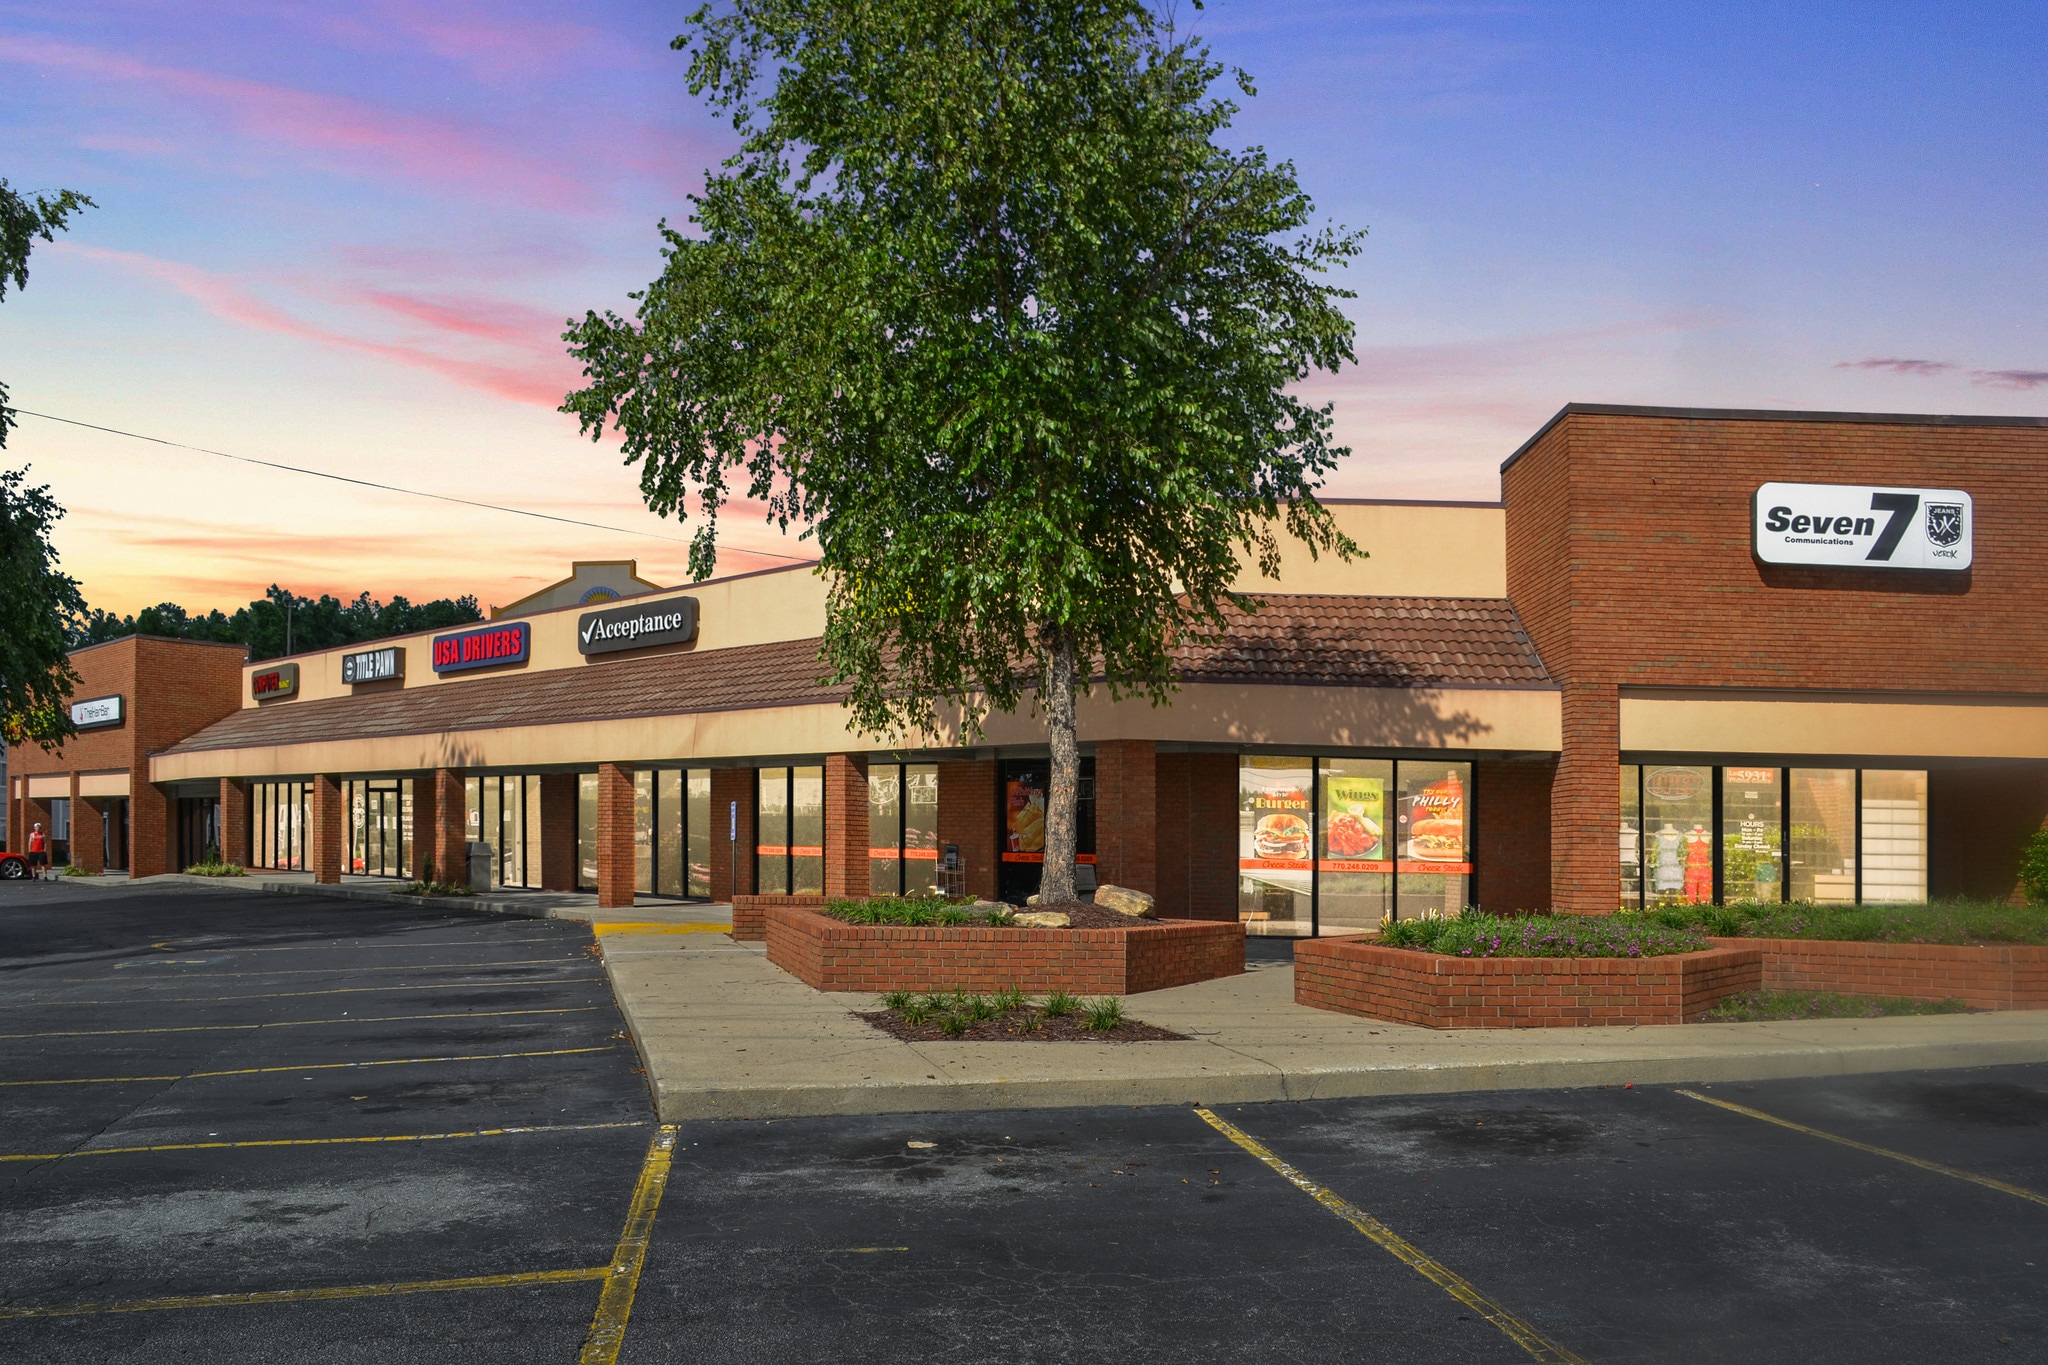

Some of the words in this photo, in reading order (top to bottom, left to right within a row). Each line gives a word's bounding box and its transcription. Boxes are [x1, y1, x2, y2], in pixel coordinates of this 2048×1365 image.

[1933, 507, 1955, 515] JEANS
[1765, 506, 1875, 536] Seven
[1865, 492, 1920, 562] 7
[1784, 536, 1854, 546] Communications
[594, 612, 682, 639] Acceptance
[434, 638, 460, 667] USA
[463, 628, 522, 662] DRIVERS
[355, 653, 374, 680] TITLE
[375, 649, 395, 678] PAWN
[1334, 788, 1379, 802] Wings
[1412, 795, 1460, 808] PHILLY
[1255, 797, 1309, 810] Burger
[1262, 860, 1286, 870] Cheese
[1287, 861, 1308, 870] Steak
[1332, 862, 1379, 871] 770.248.0209
[1417, 863, 1441, 872] Cheese
[1443, 864, 1464, 873] Steak
